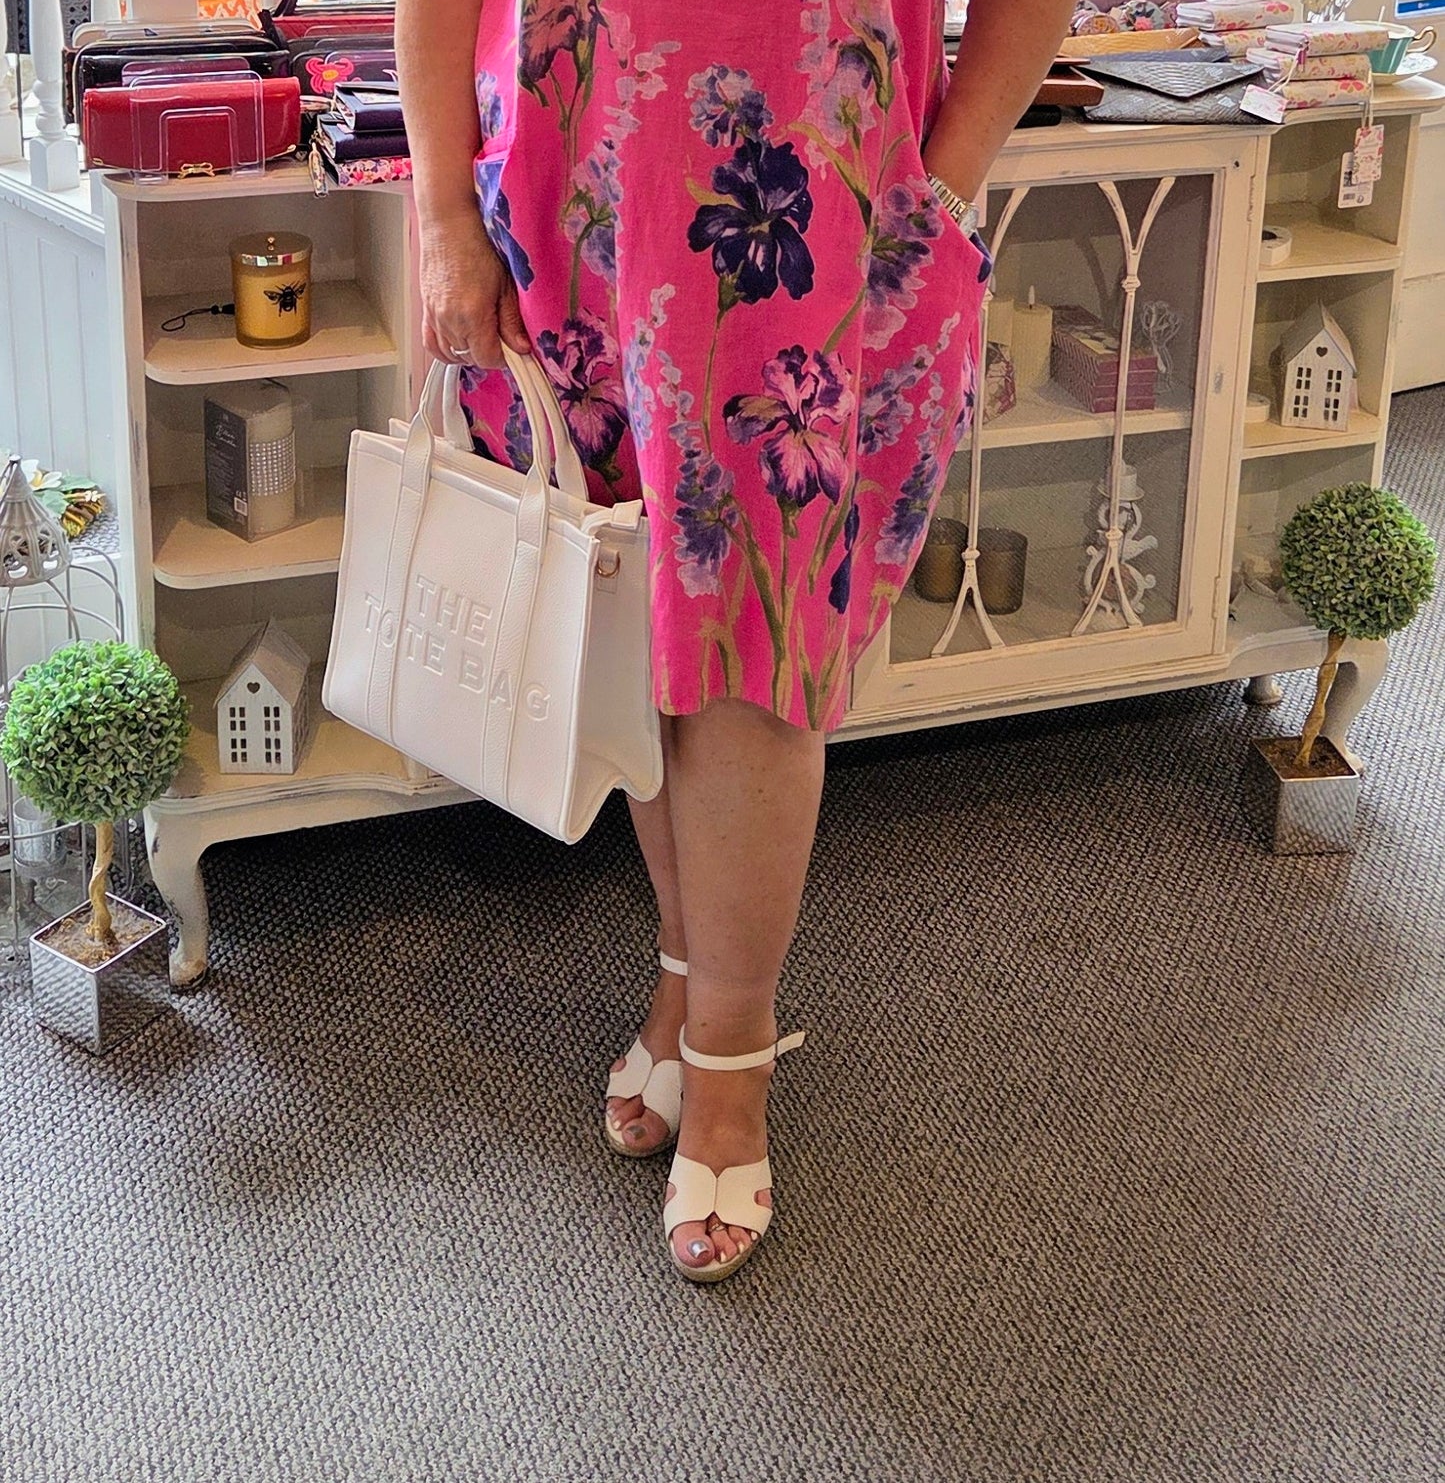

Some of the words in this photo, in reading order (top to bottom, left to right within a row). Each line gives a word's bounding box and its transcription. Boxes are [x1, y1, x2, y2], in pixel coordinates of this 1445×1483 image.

[365, 591, 446, 676] TOTE
[459, 649, 551, 722] BAG
[416, 573, 492, 647] THE
